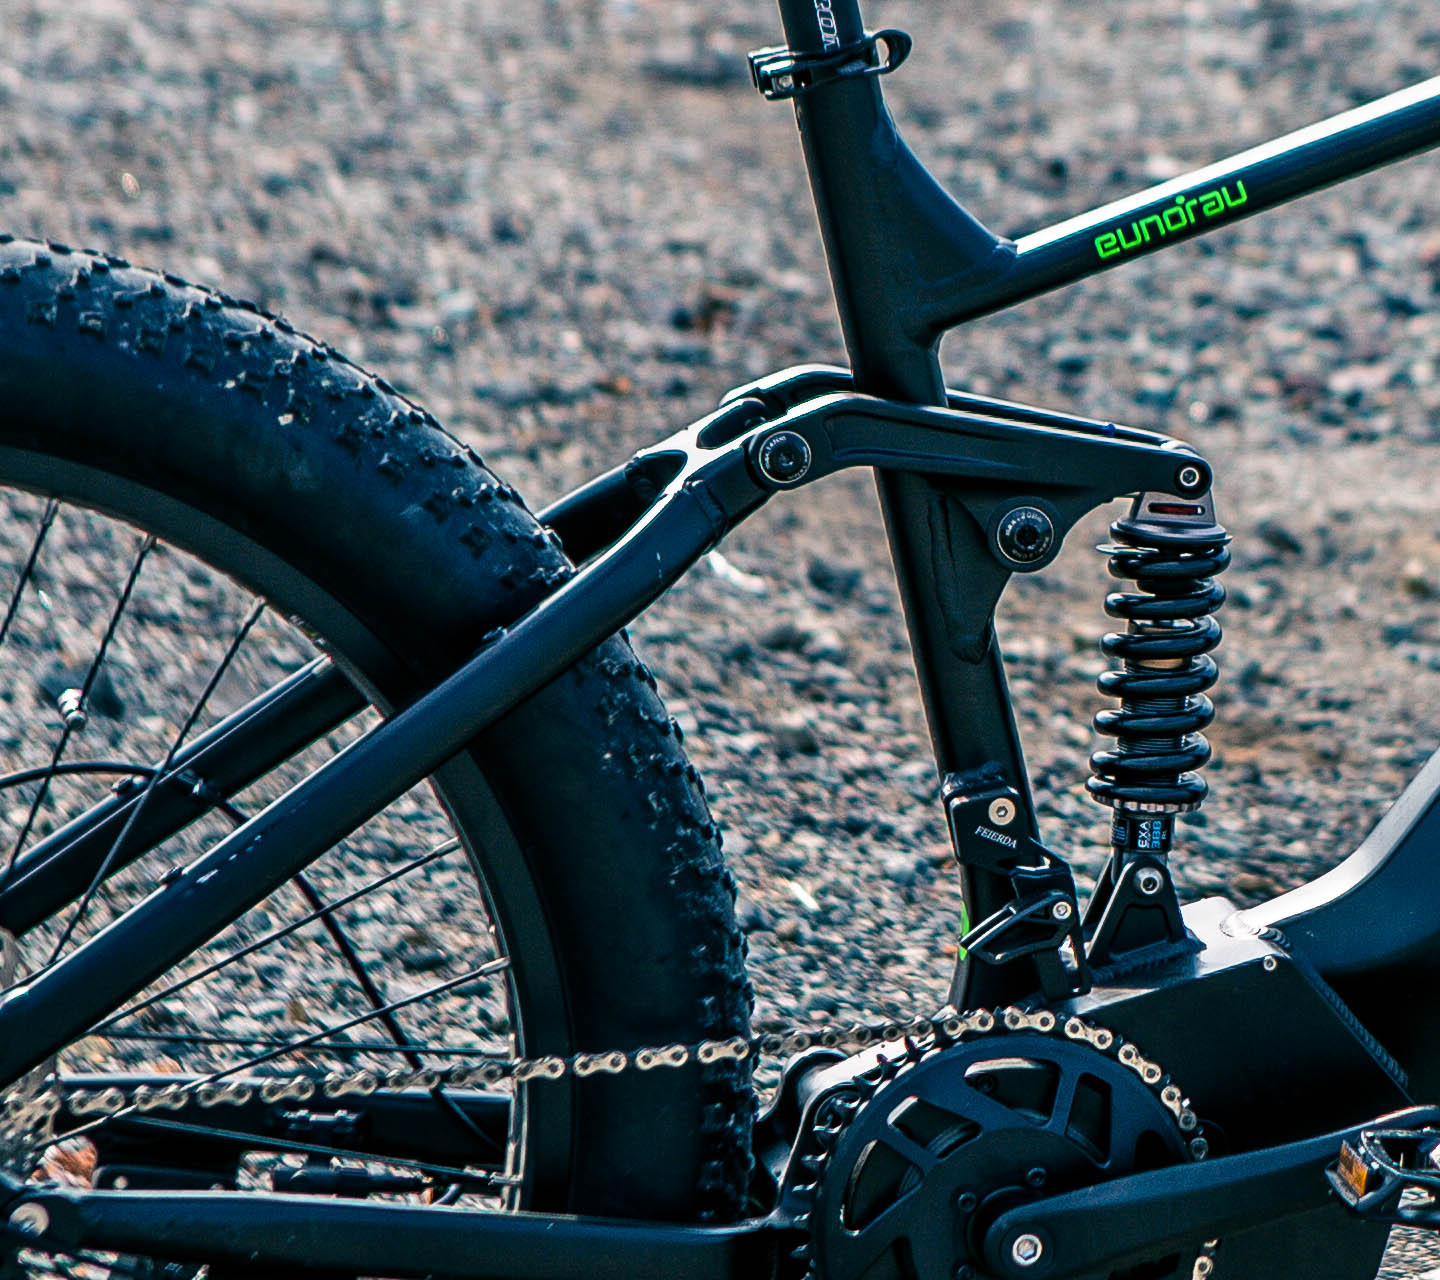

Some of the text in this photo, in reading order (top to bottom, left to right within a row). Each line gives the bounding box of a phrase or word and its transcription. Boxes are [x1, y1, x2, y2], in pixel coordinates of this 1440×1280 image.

[1094, 180, 1248, 259] eunorau
[974, 825, 1017, 849] FEIERDA
[1137, 821, 1150, 848] EXA
